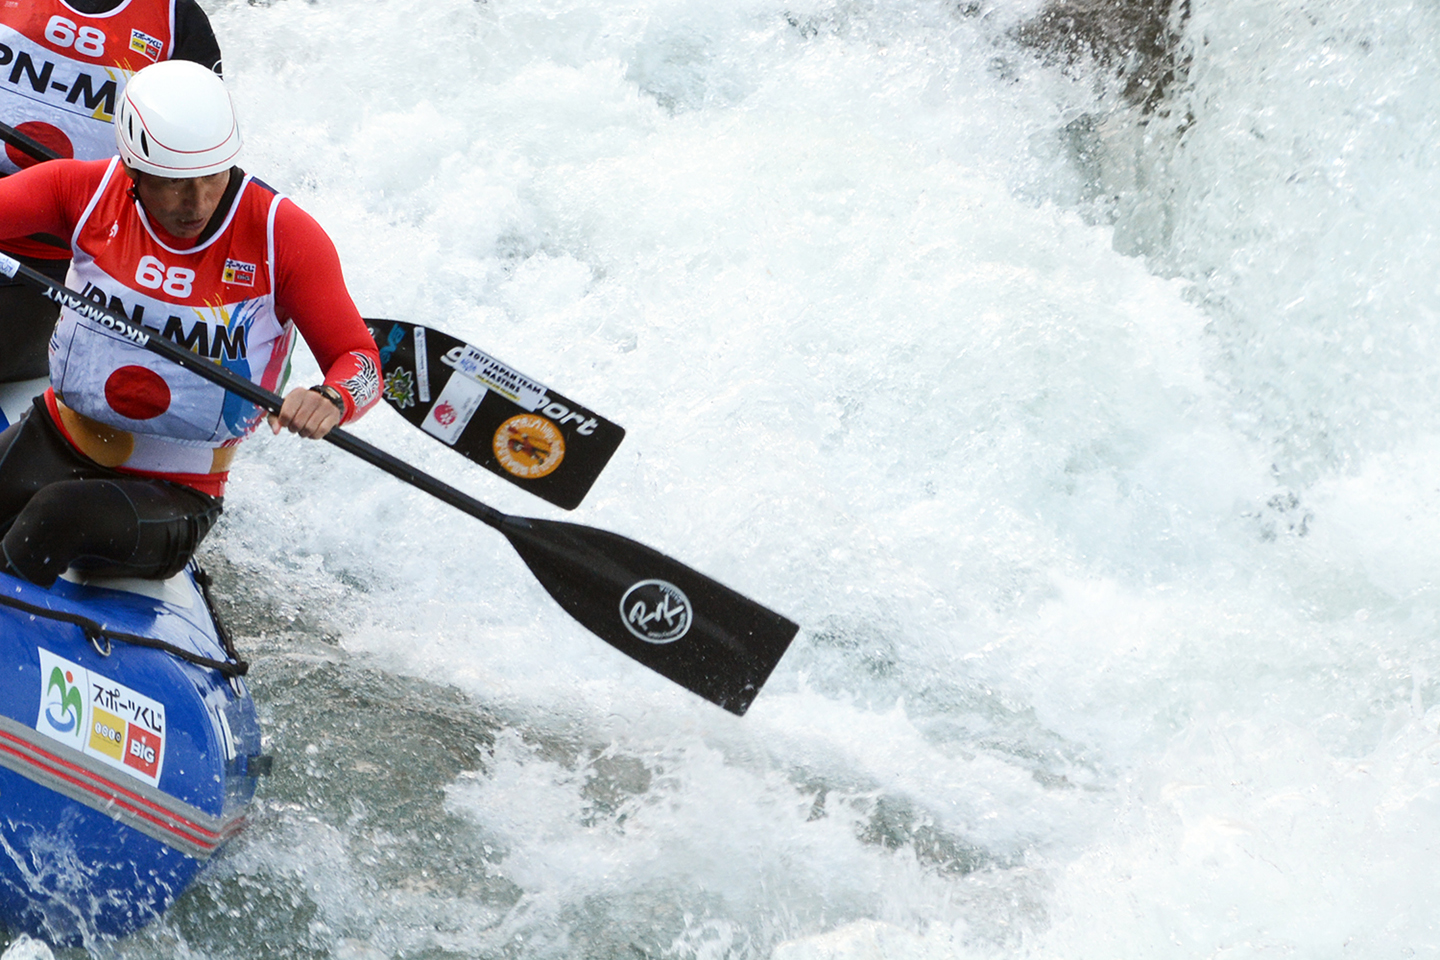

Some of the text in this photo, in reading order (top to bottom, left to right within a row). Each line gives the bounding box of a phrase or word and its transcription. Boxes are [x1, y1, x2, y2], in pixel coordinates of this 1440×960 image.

[44, 14, 106, 58] 68
[134, 255, 196, 298] 68
[482, 368, 521, 394] MASTERS
[490, 362, 517, 381] JAPAN
[517, 378, 542, 395] TEAM
[92, 683, 162, 735] スポーツくじ
[94, 721, 122, 744] toto
